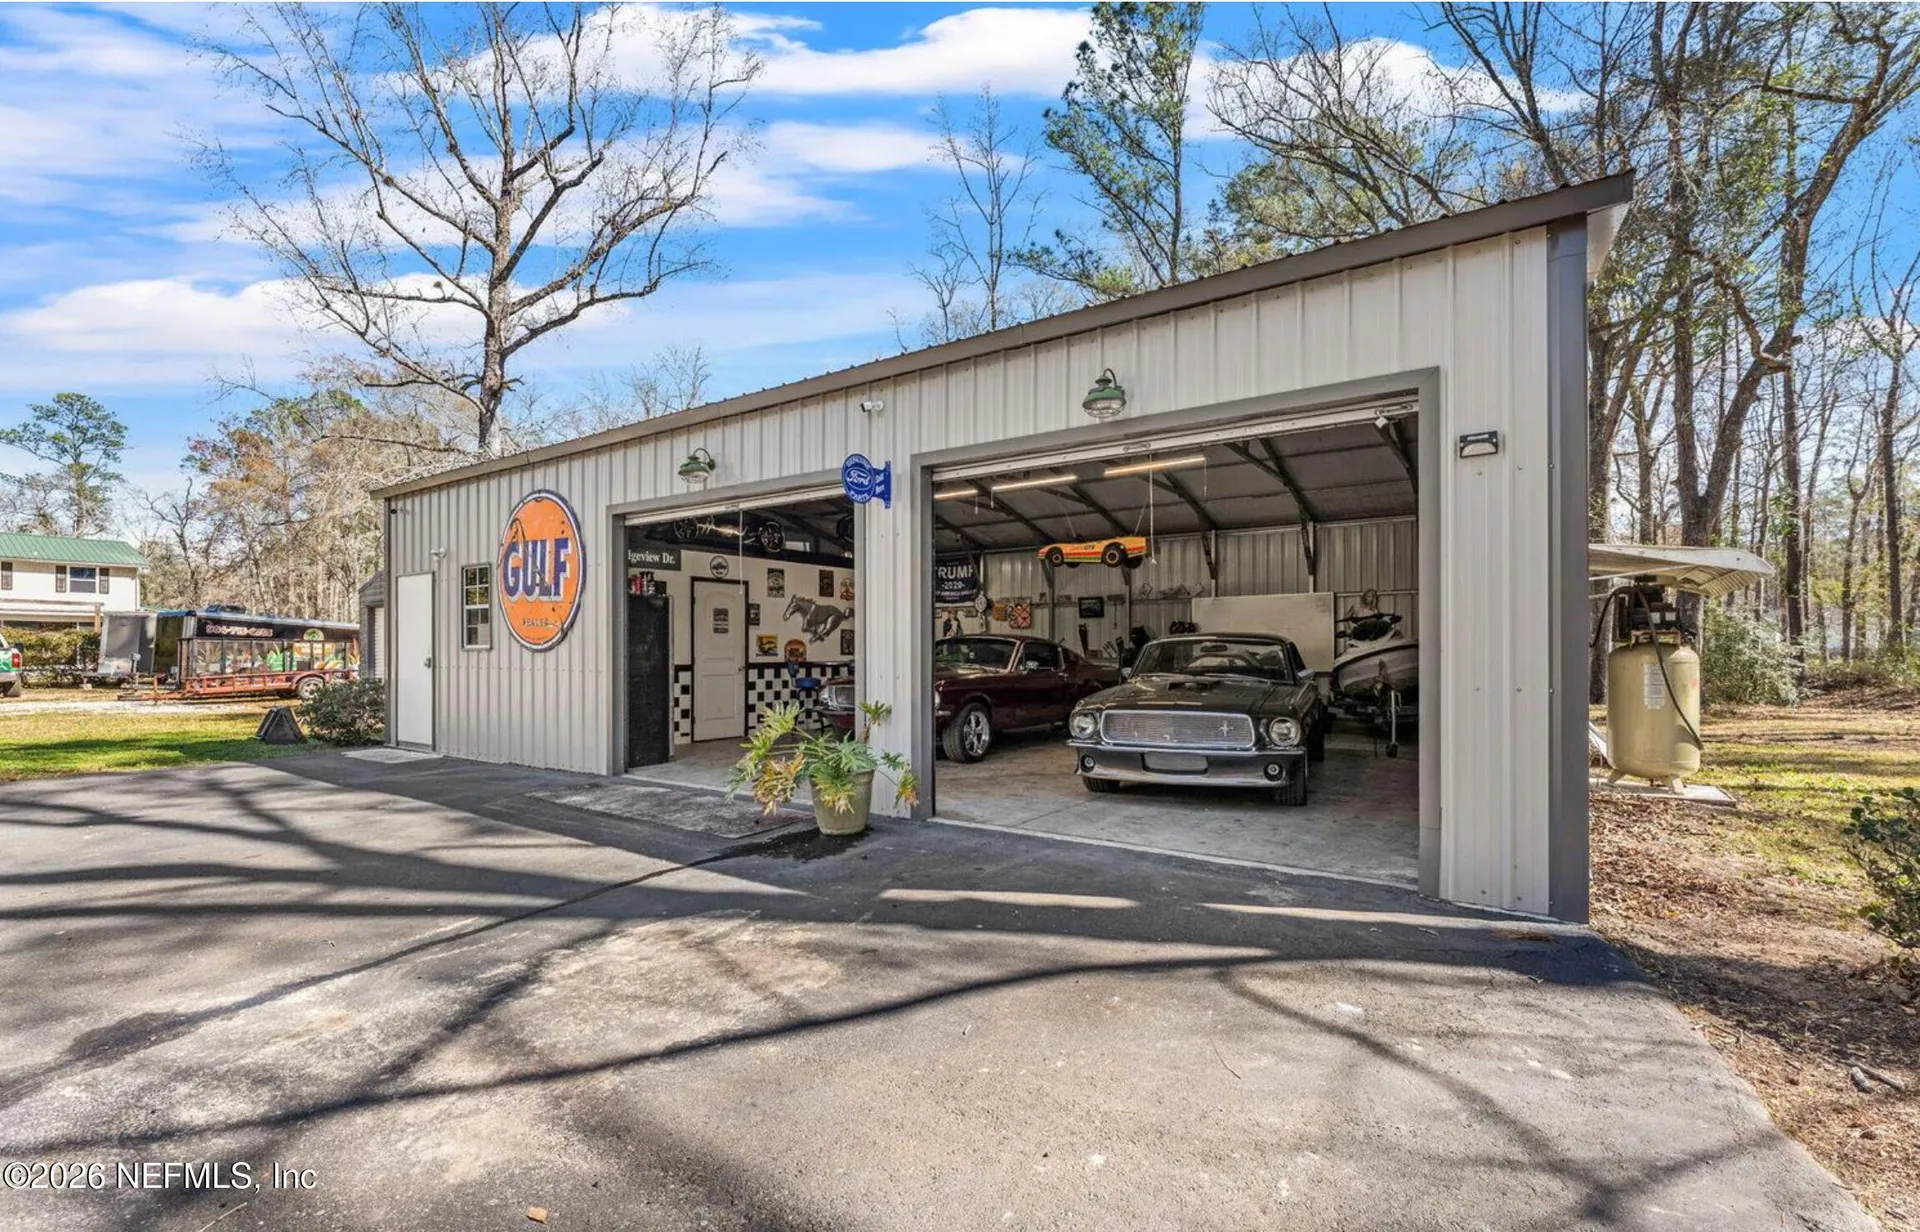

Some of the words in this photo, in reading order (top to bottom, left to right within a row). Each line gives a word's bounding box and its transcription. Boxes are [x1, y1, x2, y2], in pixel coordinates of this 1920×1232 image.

[847, 470, 870, 485] Ford
[628, 549, 660, 563] geview
[662, 552, 675, 564] Dr.
[502, 537, 572, 603] GULF
